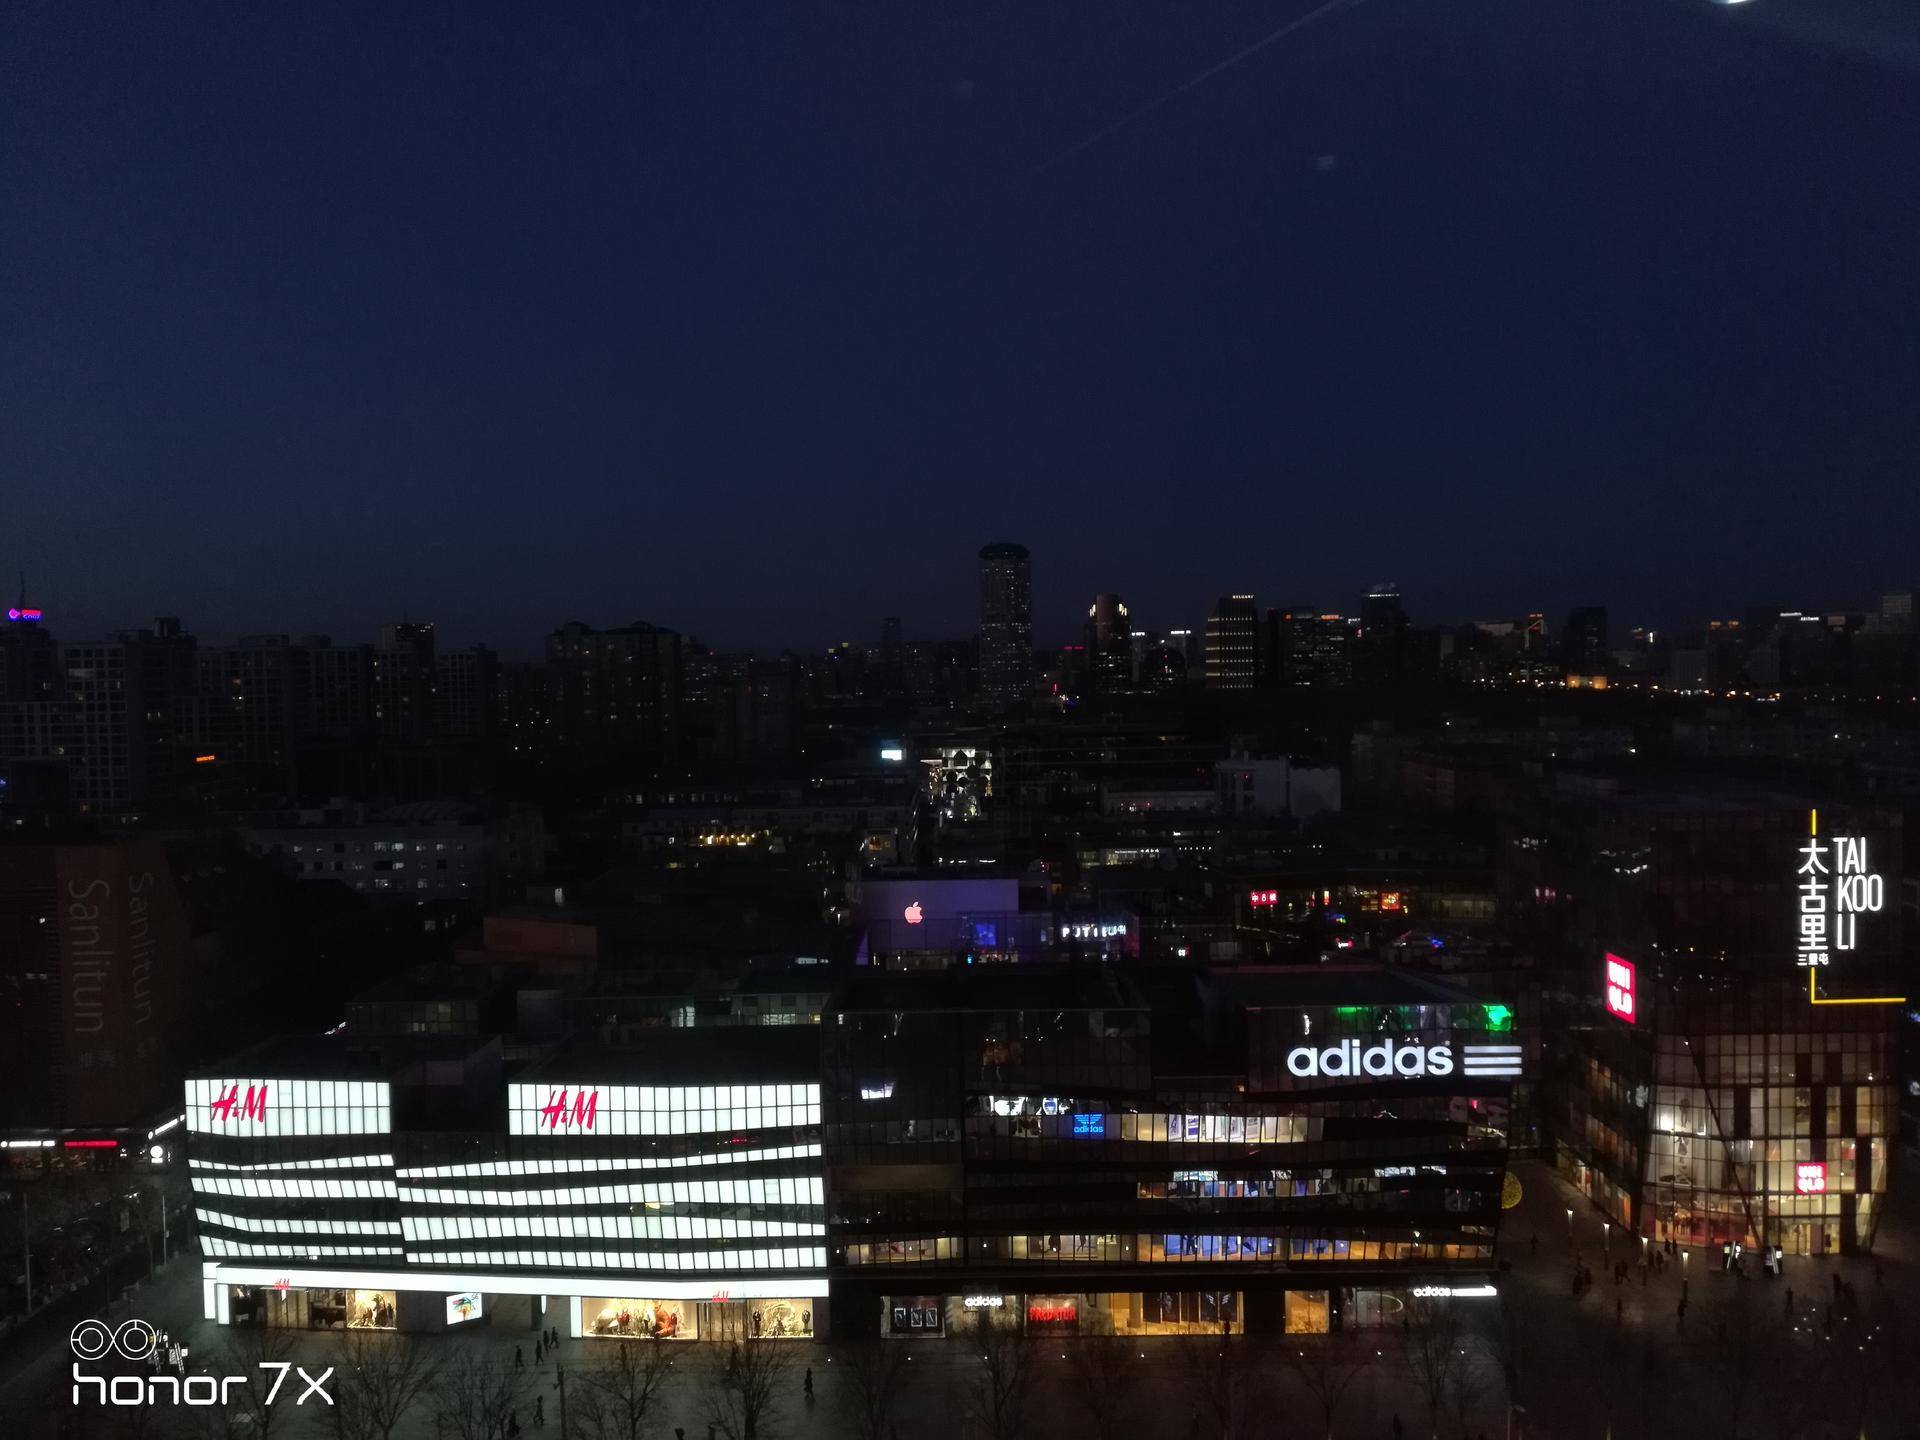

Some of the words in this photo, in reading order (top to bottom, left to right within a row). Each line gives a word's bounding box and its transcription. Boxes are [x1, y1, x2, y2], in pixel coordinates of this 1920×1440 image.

[1832, 836, 1866, 874] TAI
[1798, 838, 1829, 950] 太古里
[1837, 874, 1883, 912] KOO
[128, 871, 158, 1025] Sanlitun
[1837, 913, 1856, 950] LI
[68, 879, 114, 1033] Sanlitun
[1287, 1038, 1454, 1077] adidas
[210, 1084, 268, 1122] H&M
[539, 1090, 599, 1130] H&M
[1073, 1124, 1104, 1133] adidas
[965, 1296, 1003, 1307] adidas
